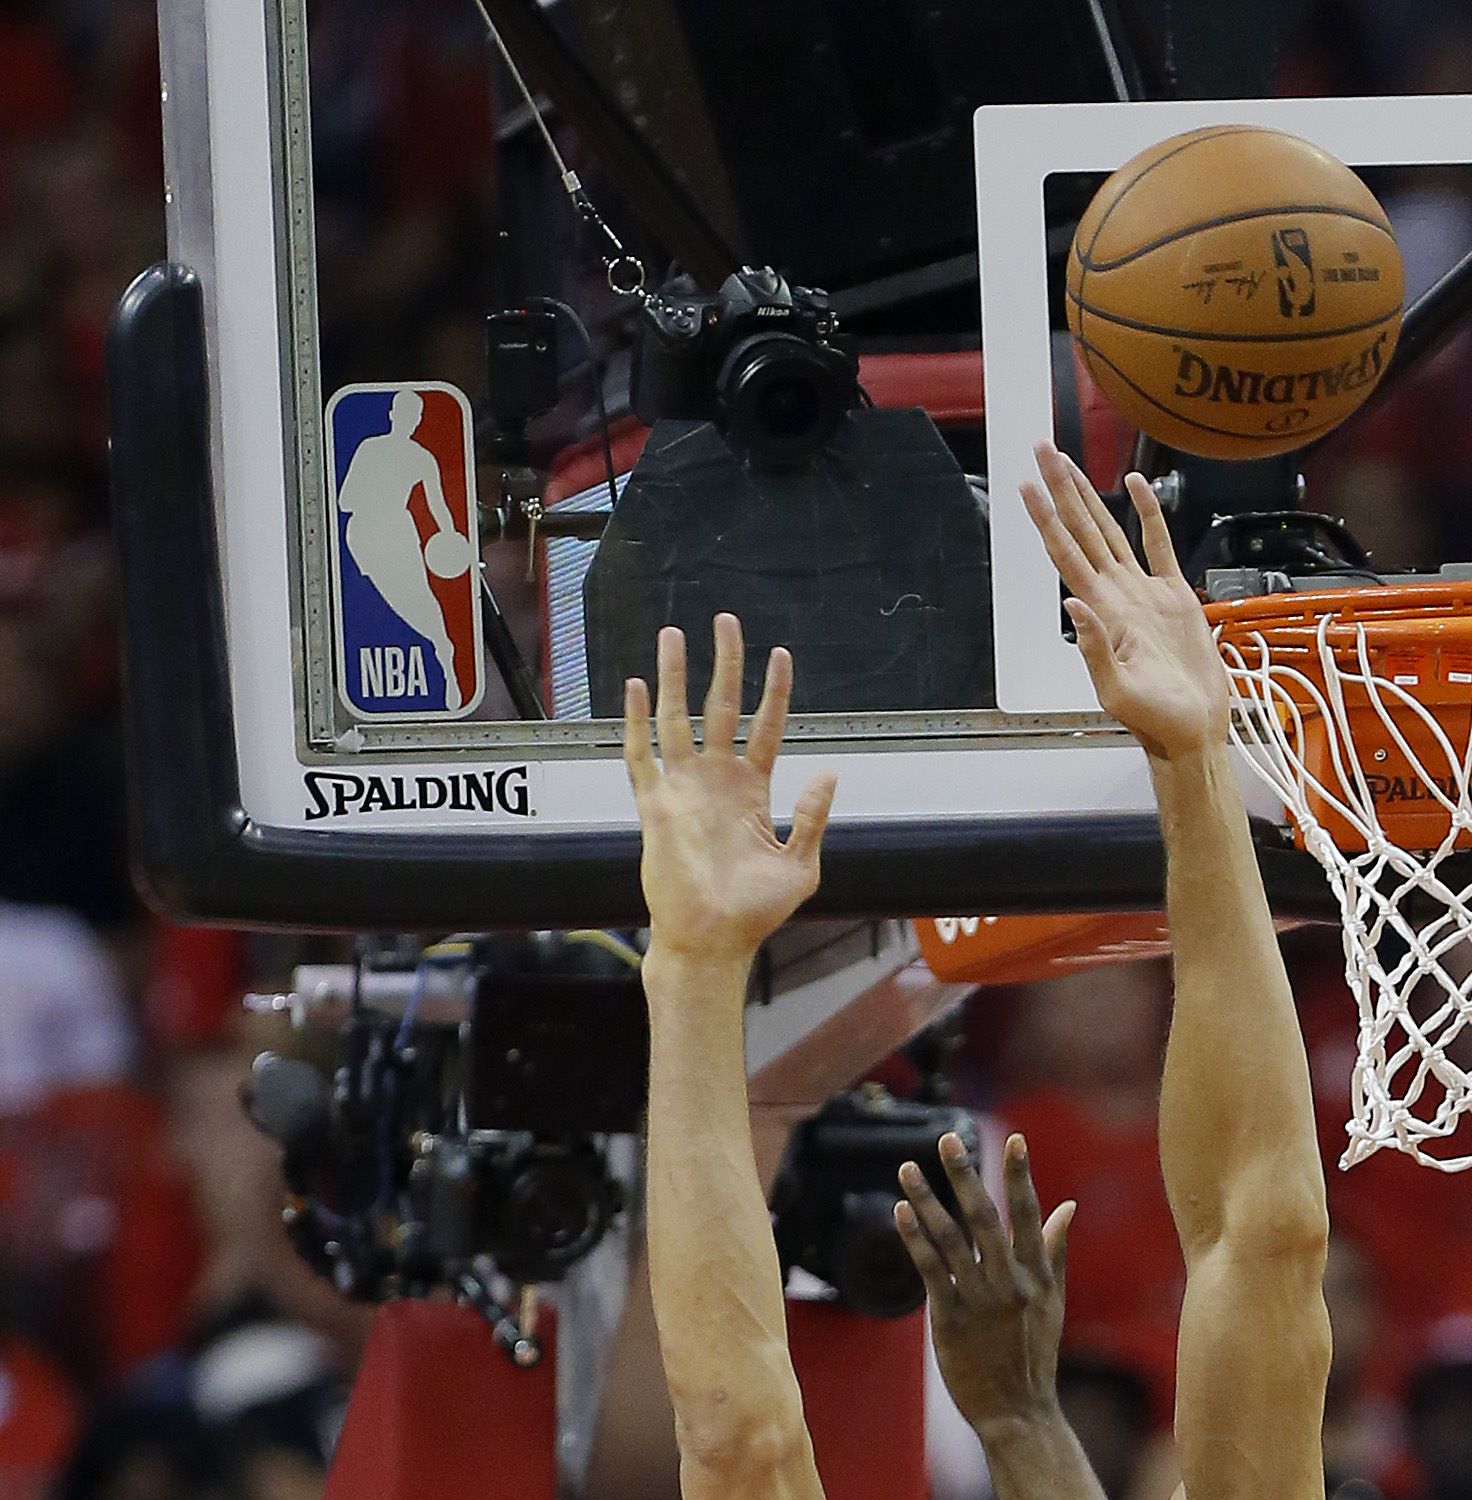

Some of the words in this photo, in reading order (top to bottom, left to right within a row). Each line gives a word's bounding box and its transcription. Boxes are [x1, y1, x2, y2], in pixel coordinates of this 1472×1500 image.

[757, 307, 790, 317] Nikon
[1173, 332, 1388, 403] SPALDING
[360, 647, 429, 699] NBA
[304, 765, 530, 820] SPALDING
